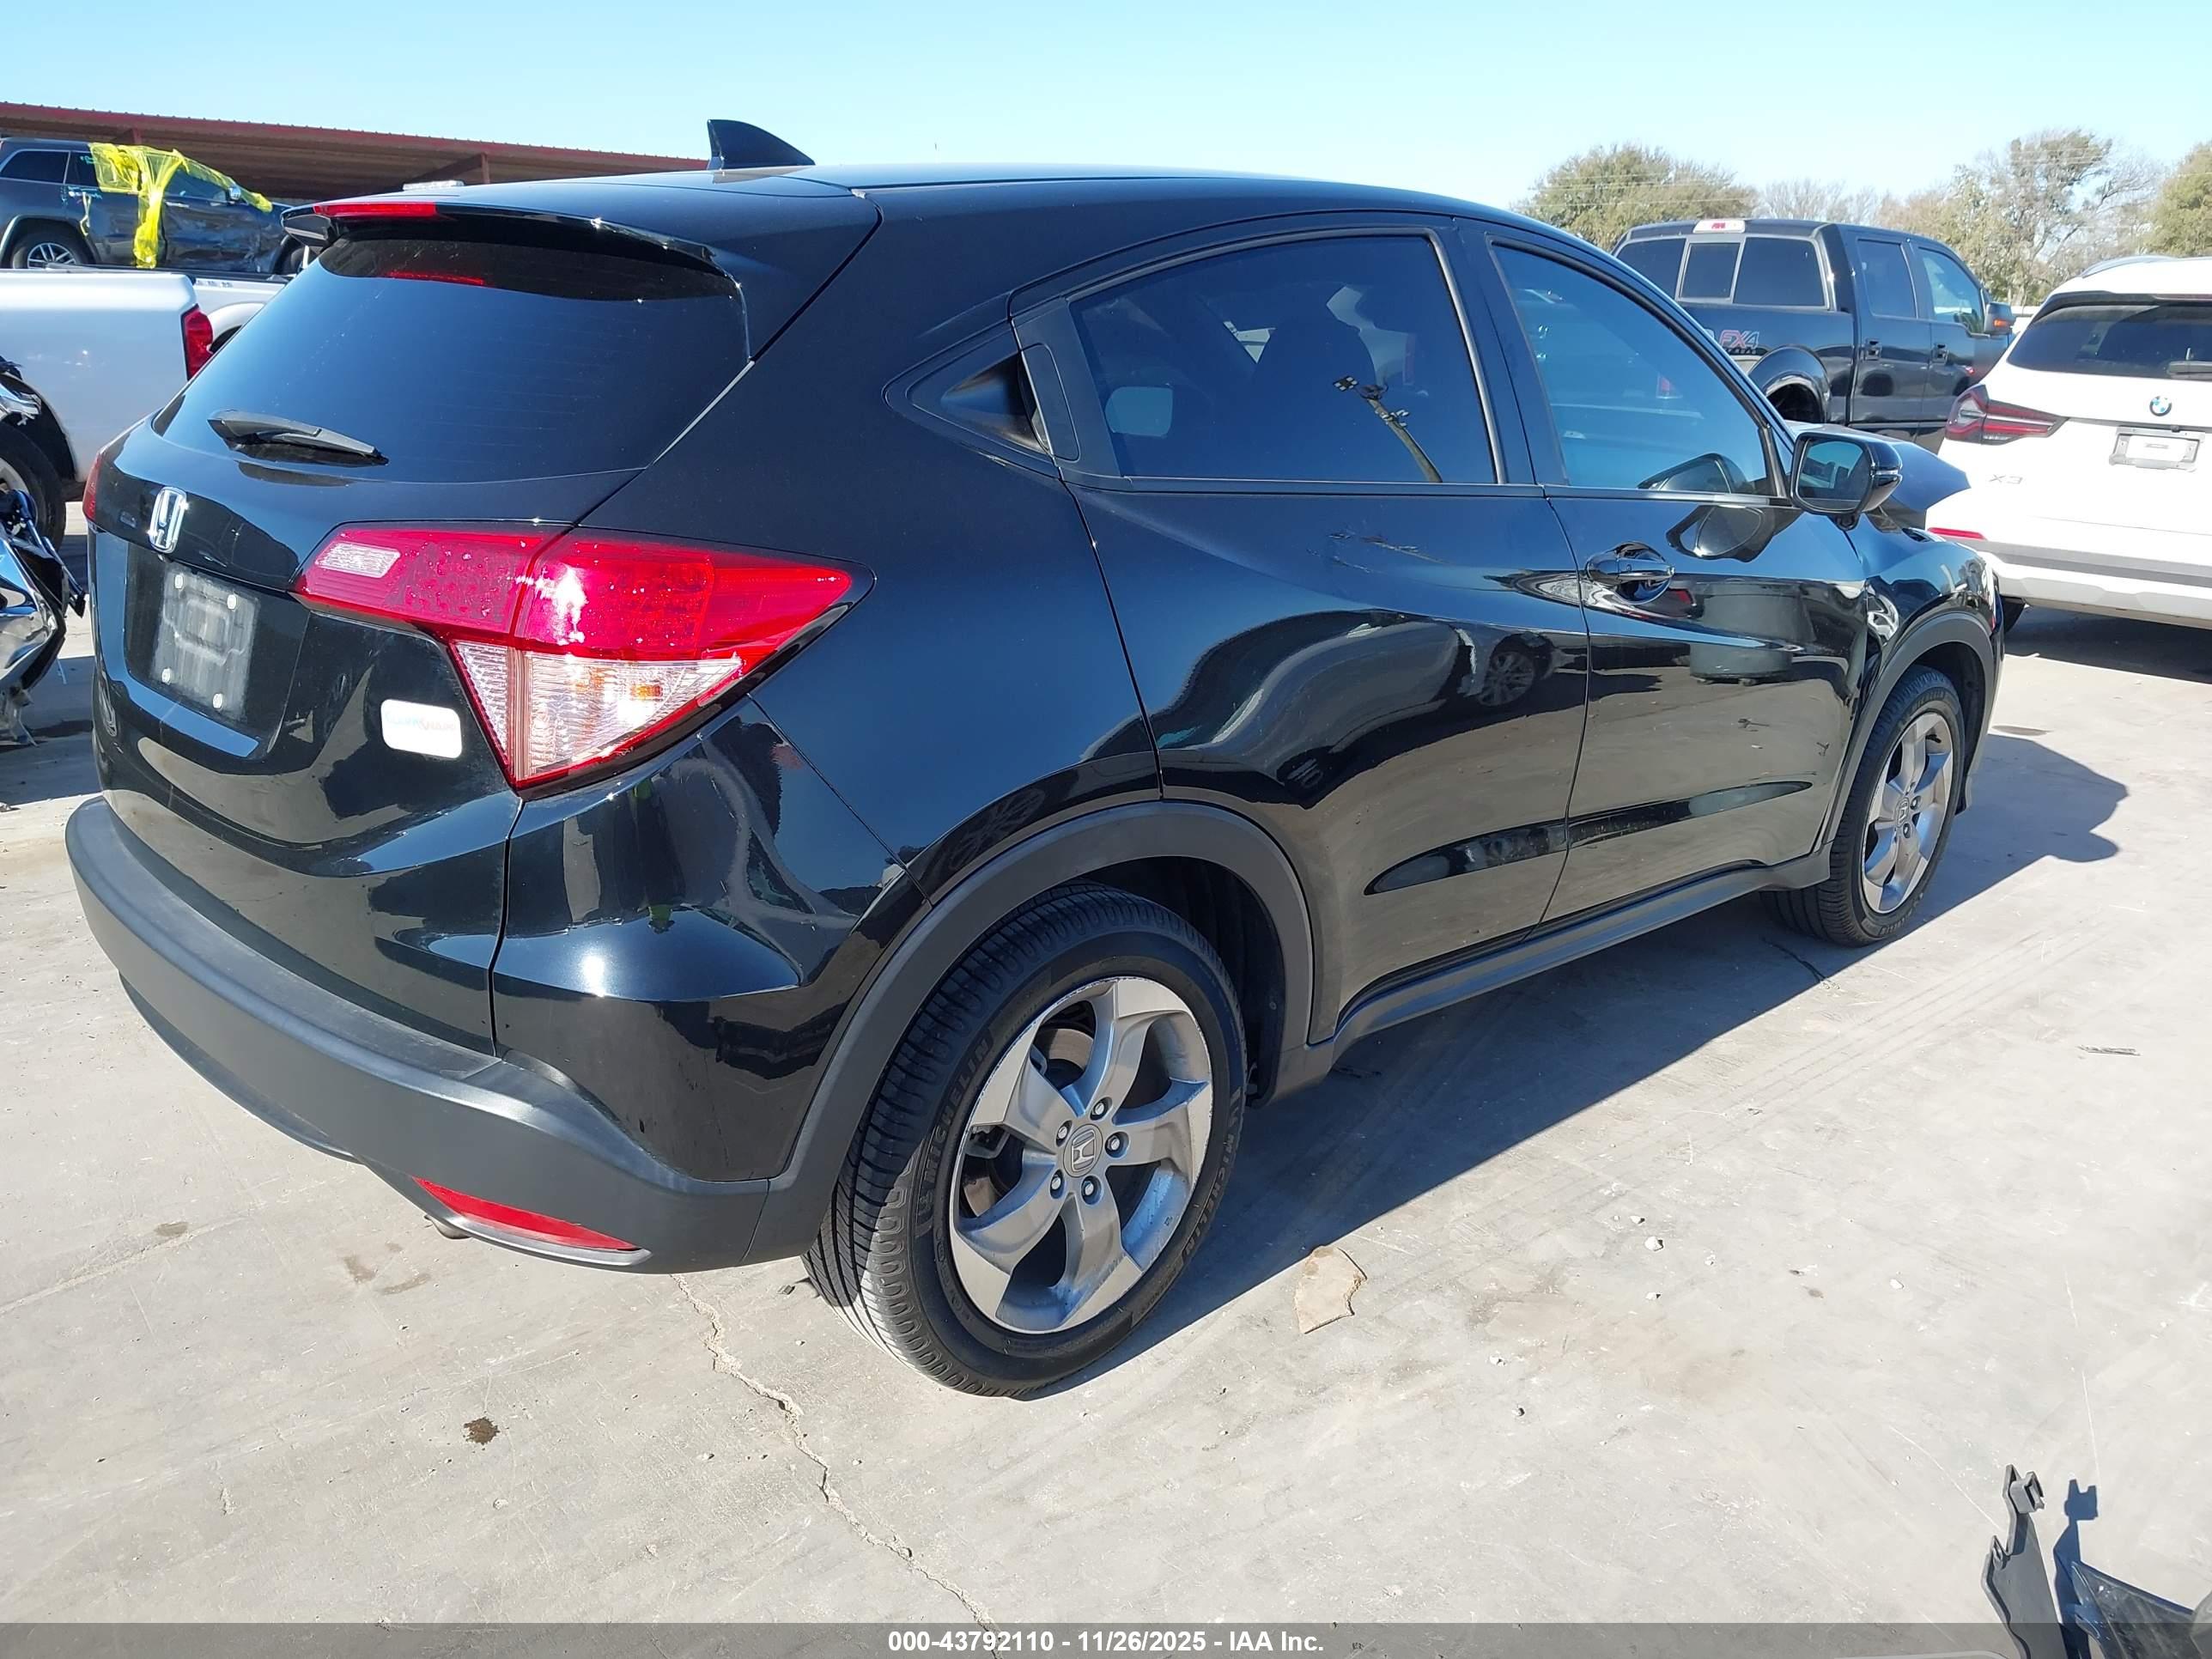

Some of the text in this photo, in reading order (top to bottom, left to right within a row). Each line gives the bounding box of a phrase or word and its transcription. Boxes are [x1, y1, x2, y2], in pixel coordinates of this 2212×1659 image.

[1719, 329, 1759, 349] FX4
[1988, 473, 2024, 485] X3
[922, 1037, 990, 1184] MICHELIN
[1184, 1133, 1236, 1257] MICHELIN
